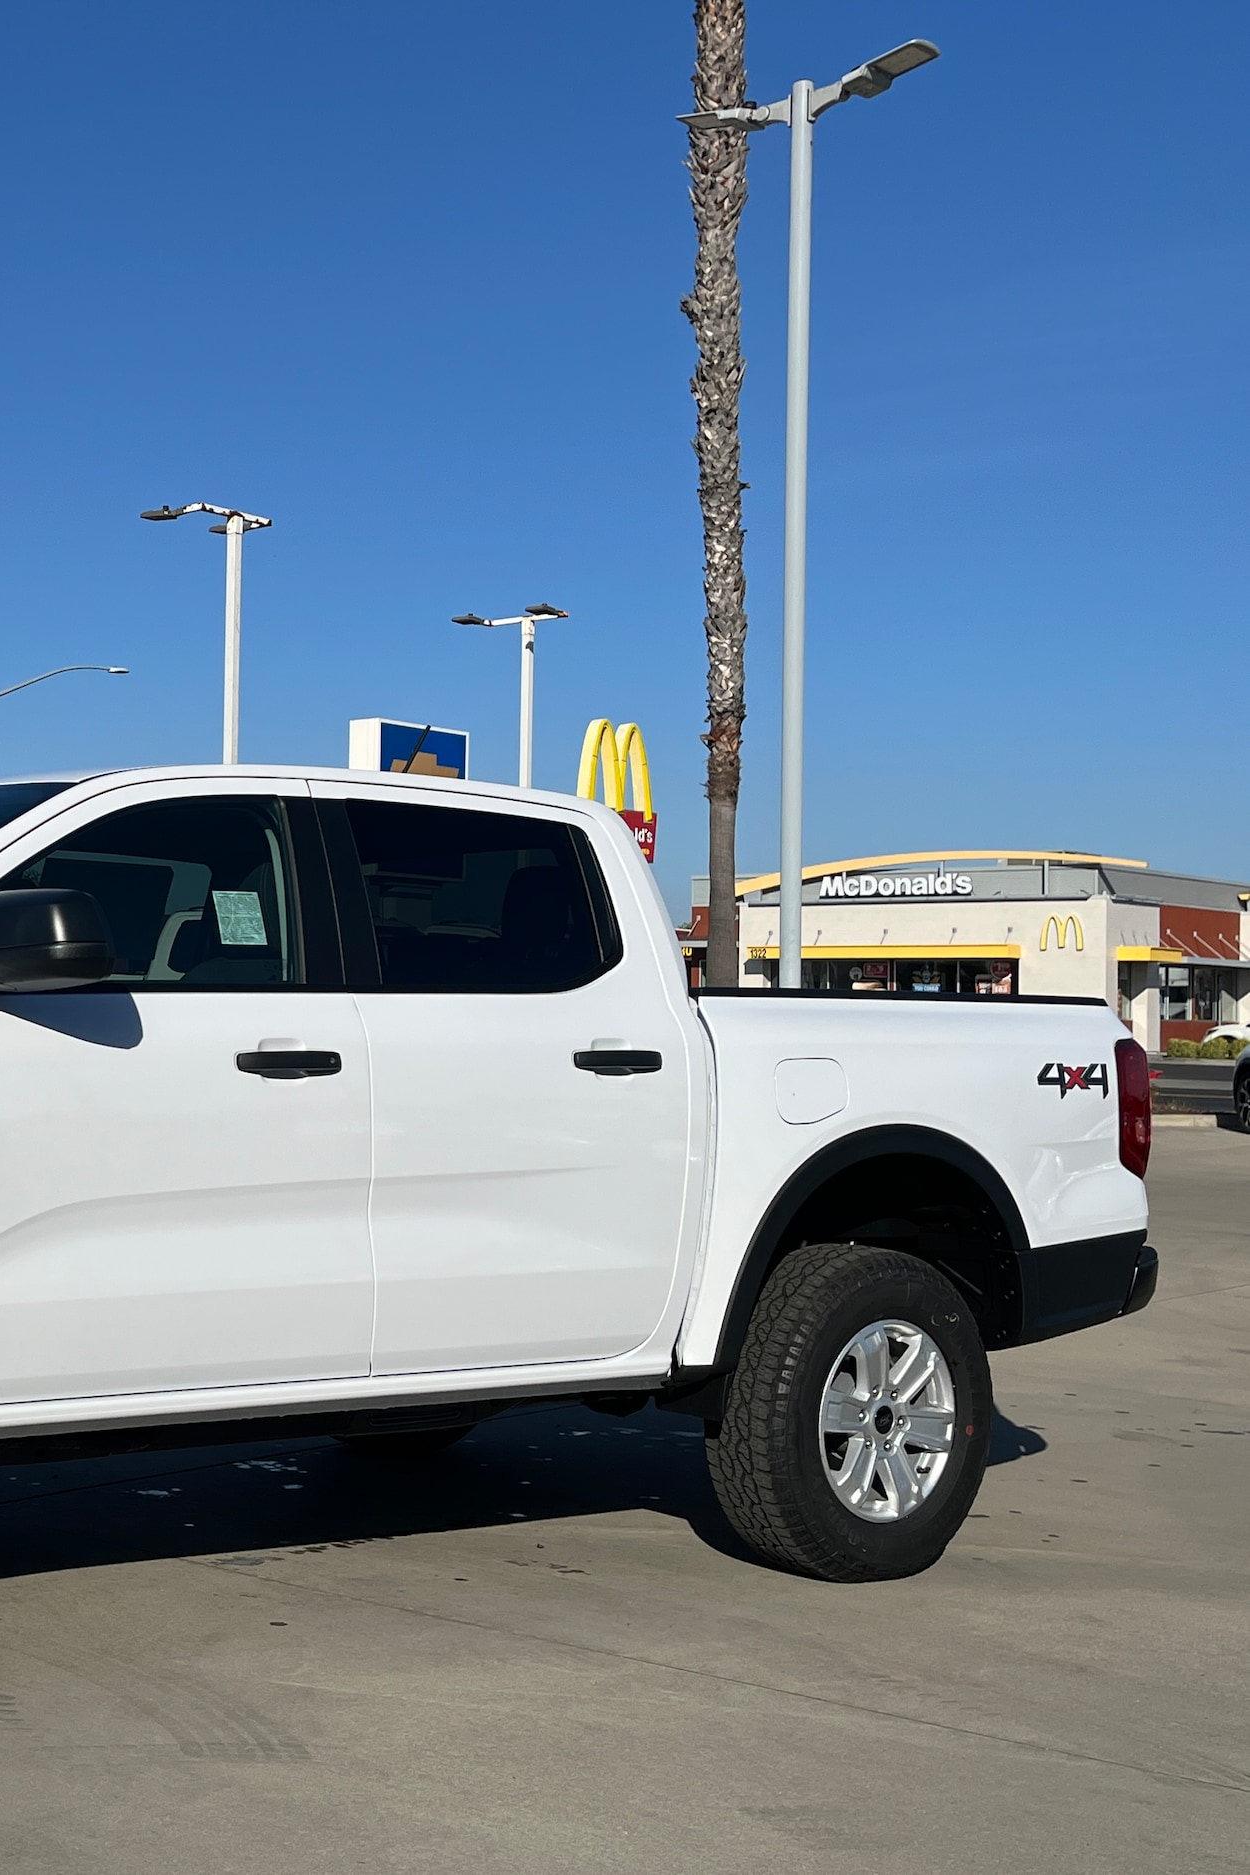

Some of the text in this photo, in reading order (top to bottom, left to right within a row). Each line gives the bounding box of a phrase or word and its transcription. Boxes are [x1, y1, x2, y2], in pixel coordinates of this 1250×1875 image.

[819, 873, 973, 897] McDonald's
[750, 948, 767, 959] 1322
[1037, 1063, 1109, 1099] 4x4
